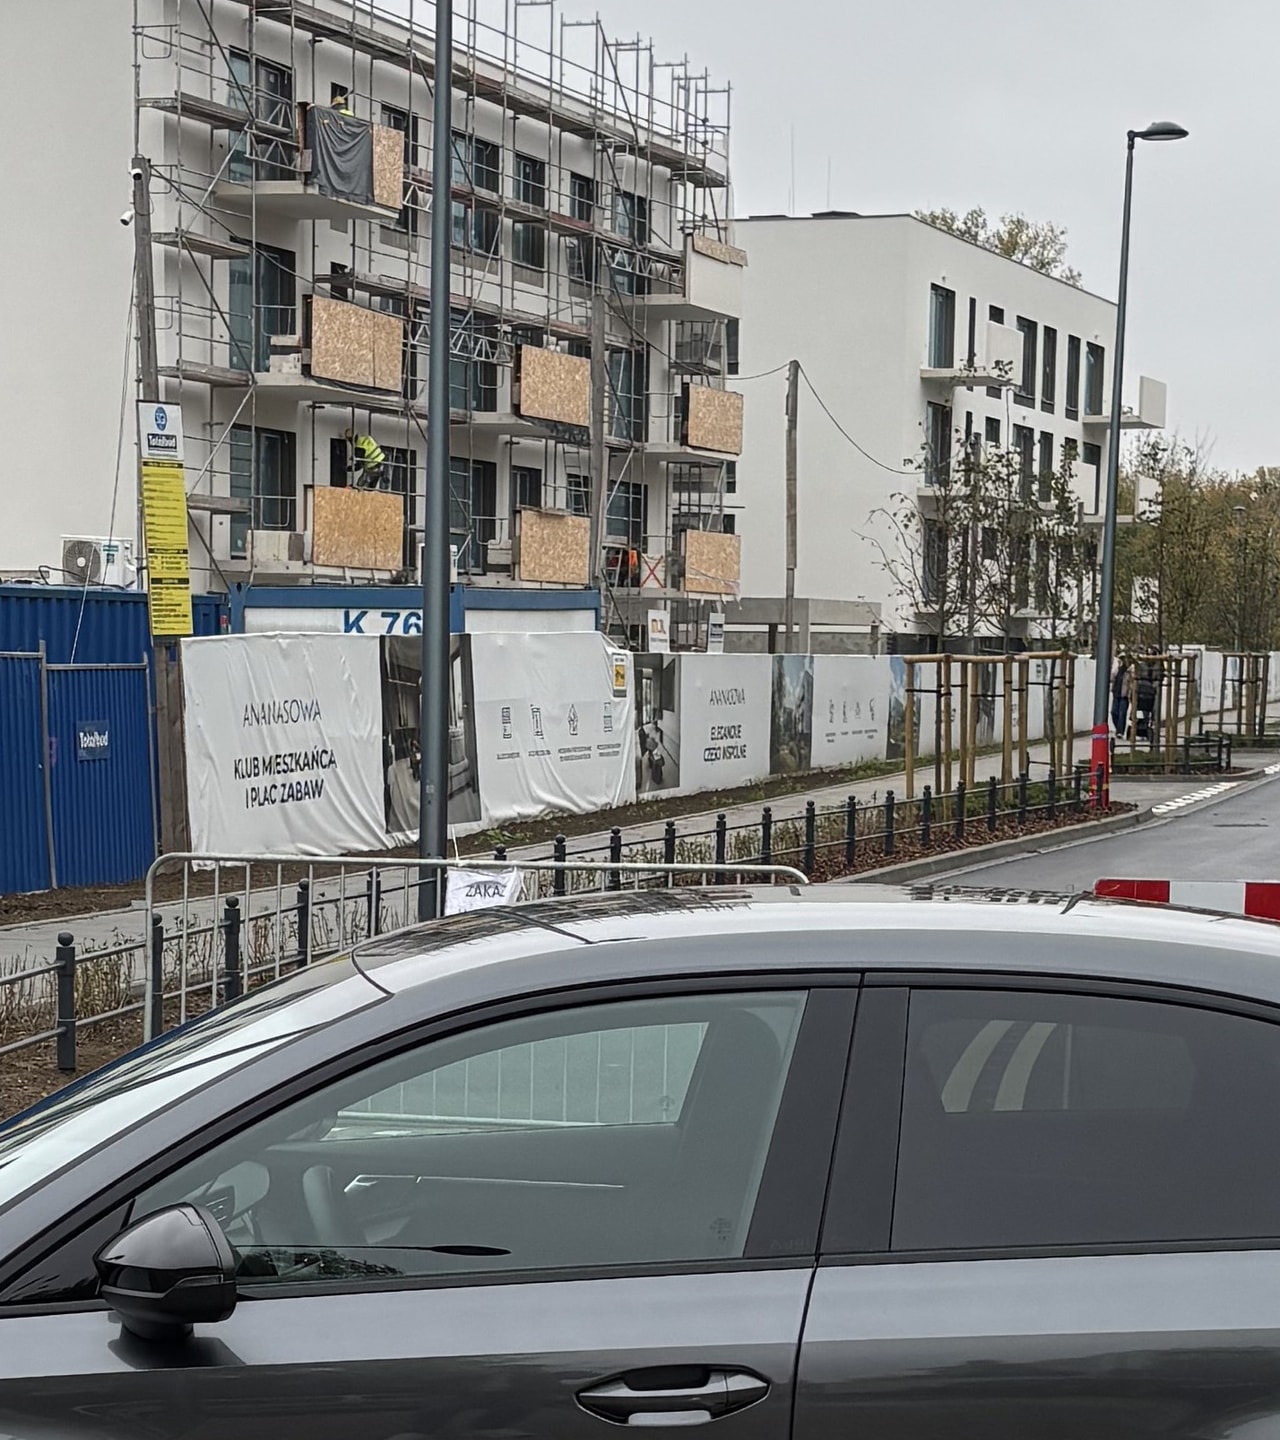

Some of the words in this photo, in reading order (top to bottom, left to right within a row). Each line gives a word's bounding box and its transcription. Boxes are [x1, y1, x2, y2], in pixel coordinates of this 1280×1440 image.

[343, 609, 369, 634] K
[243, 699, 322, 728] ANANASOWA
[233, 756, 260, 781] KLUB
[262, 745, 338, 778] MIESZKAŃCA
[245, 788, 250, 809] I
[251, 785, 277, 808] PLAC
[281, 778, 325, 804] ZABAW
